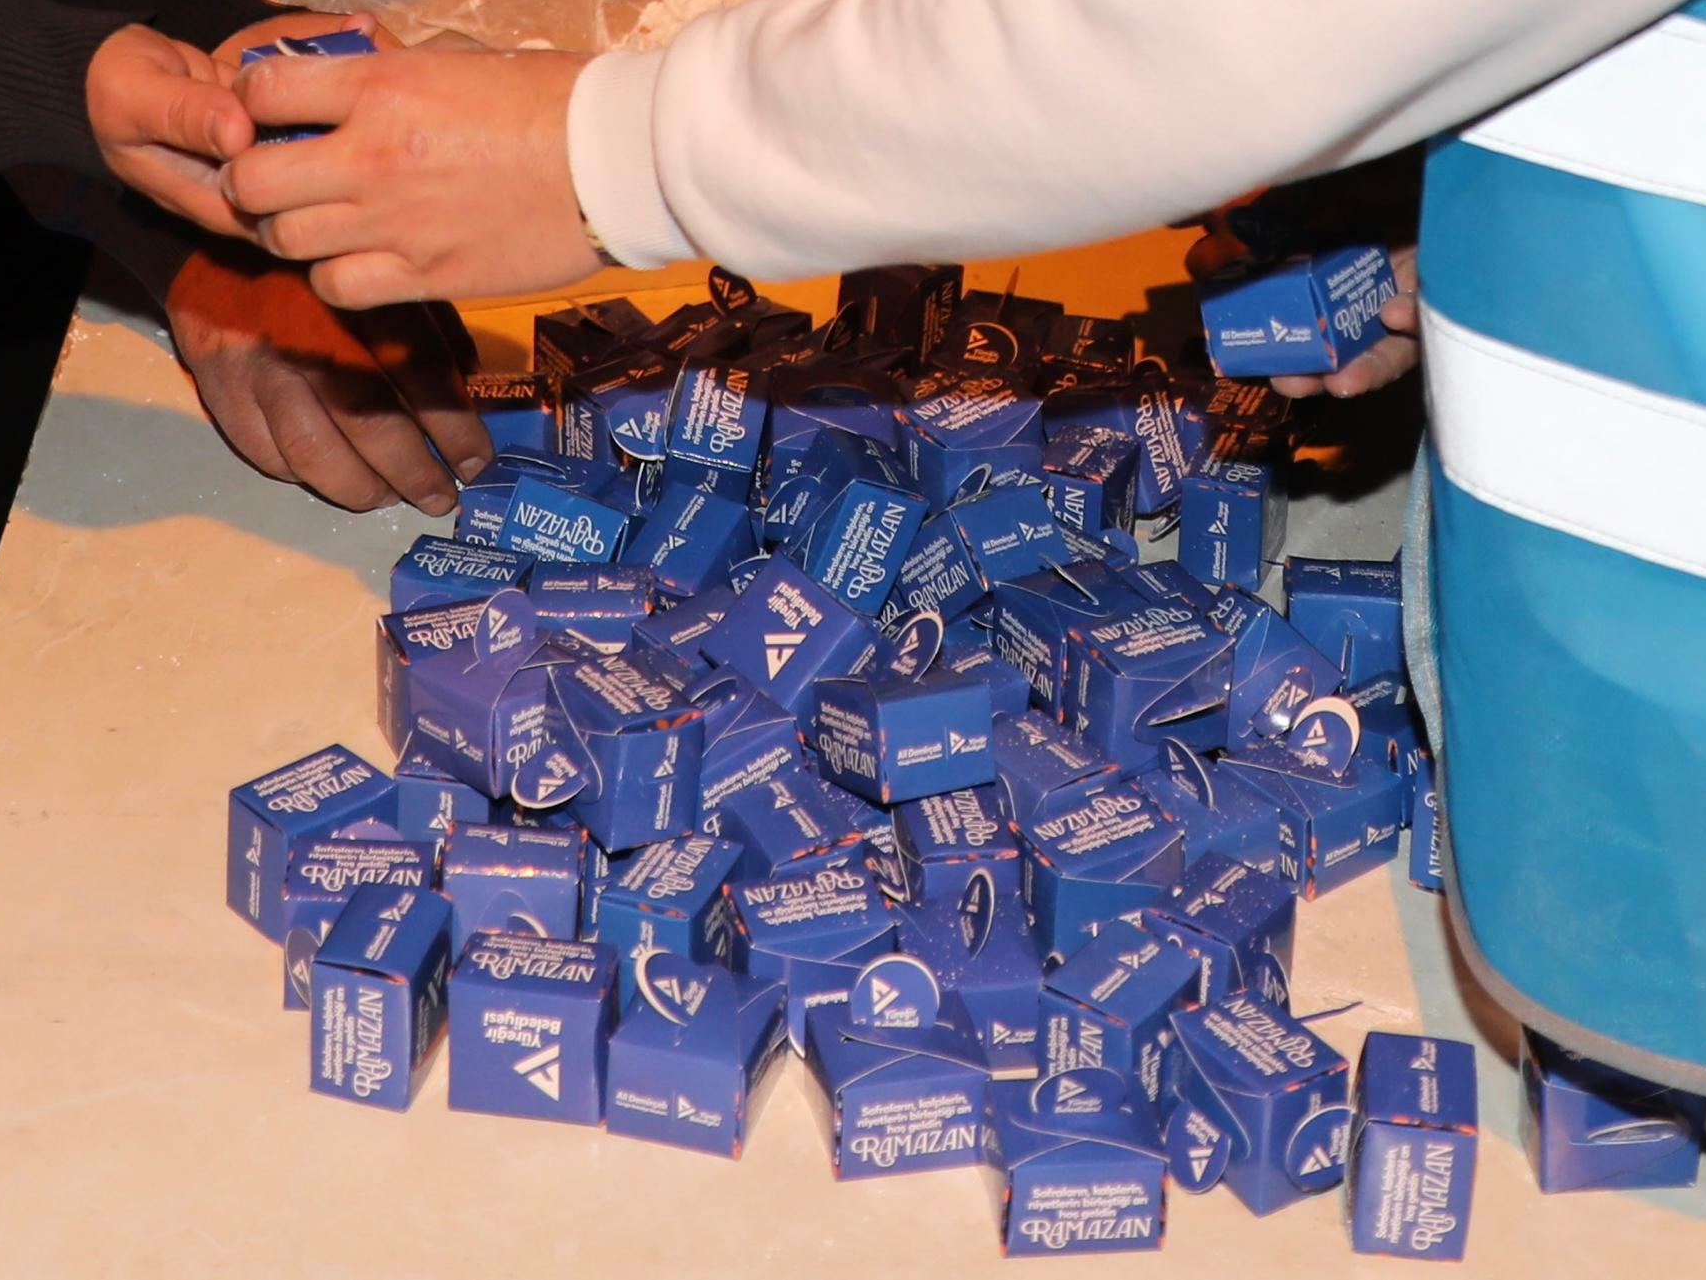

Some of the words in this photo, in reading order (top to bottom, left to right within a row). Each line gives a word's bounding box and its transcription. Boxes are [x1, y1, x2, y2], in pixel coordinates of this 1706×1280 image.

[708, 366, 750, 453] RAMAZAN
[511, 500, 605, 556] RAMAZAN
[844, 499, 907, 599] RAMAZAN
[414, 553, 517, 582] RAMAZAN
[907, 557, 972, 614] RAMAZAN
[763, 591, 803, 631] Yüreğir
[773, 579, 824, 628] Belediyesi
[405, 621, 476, 651] RAMA
[264, 764, 373, 815] RAMAZAN
[949, 786, 999, 847] RAMAZA
[1032, 794, 1143, 841] RAMAZAN
[300, 864, 424, 891] RAMAZAN
[743, 870, 866, 905] RAMAZAN
[471, 951, 597, 983] RAMAZAN
[353, 985, 391, 1096] RAMAZAN
[483, 1009, 562, 1036] Belediyesi
[483, 1025, 543, 1049] Yüreğir
[850, 1123, 978, 1169] RAMAZAN
[1410, 1141, 1456, 1252] RAMAZAN
[1019, 1216, 1153, 1251] RAMAZAN
